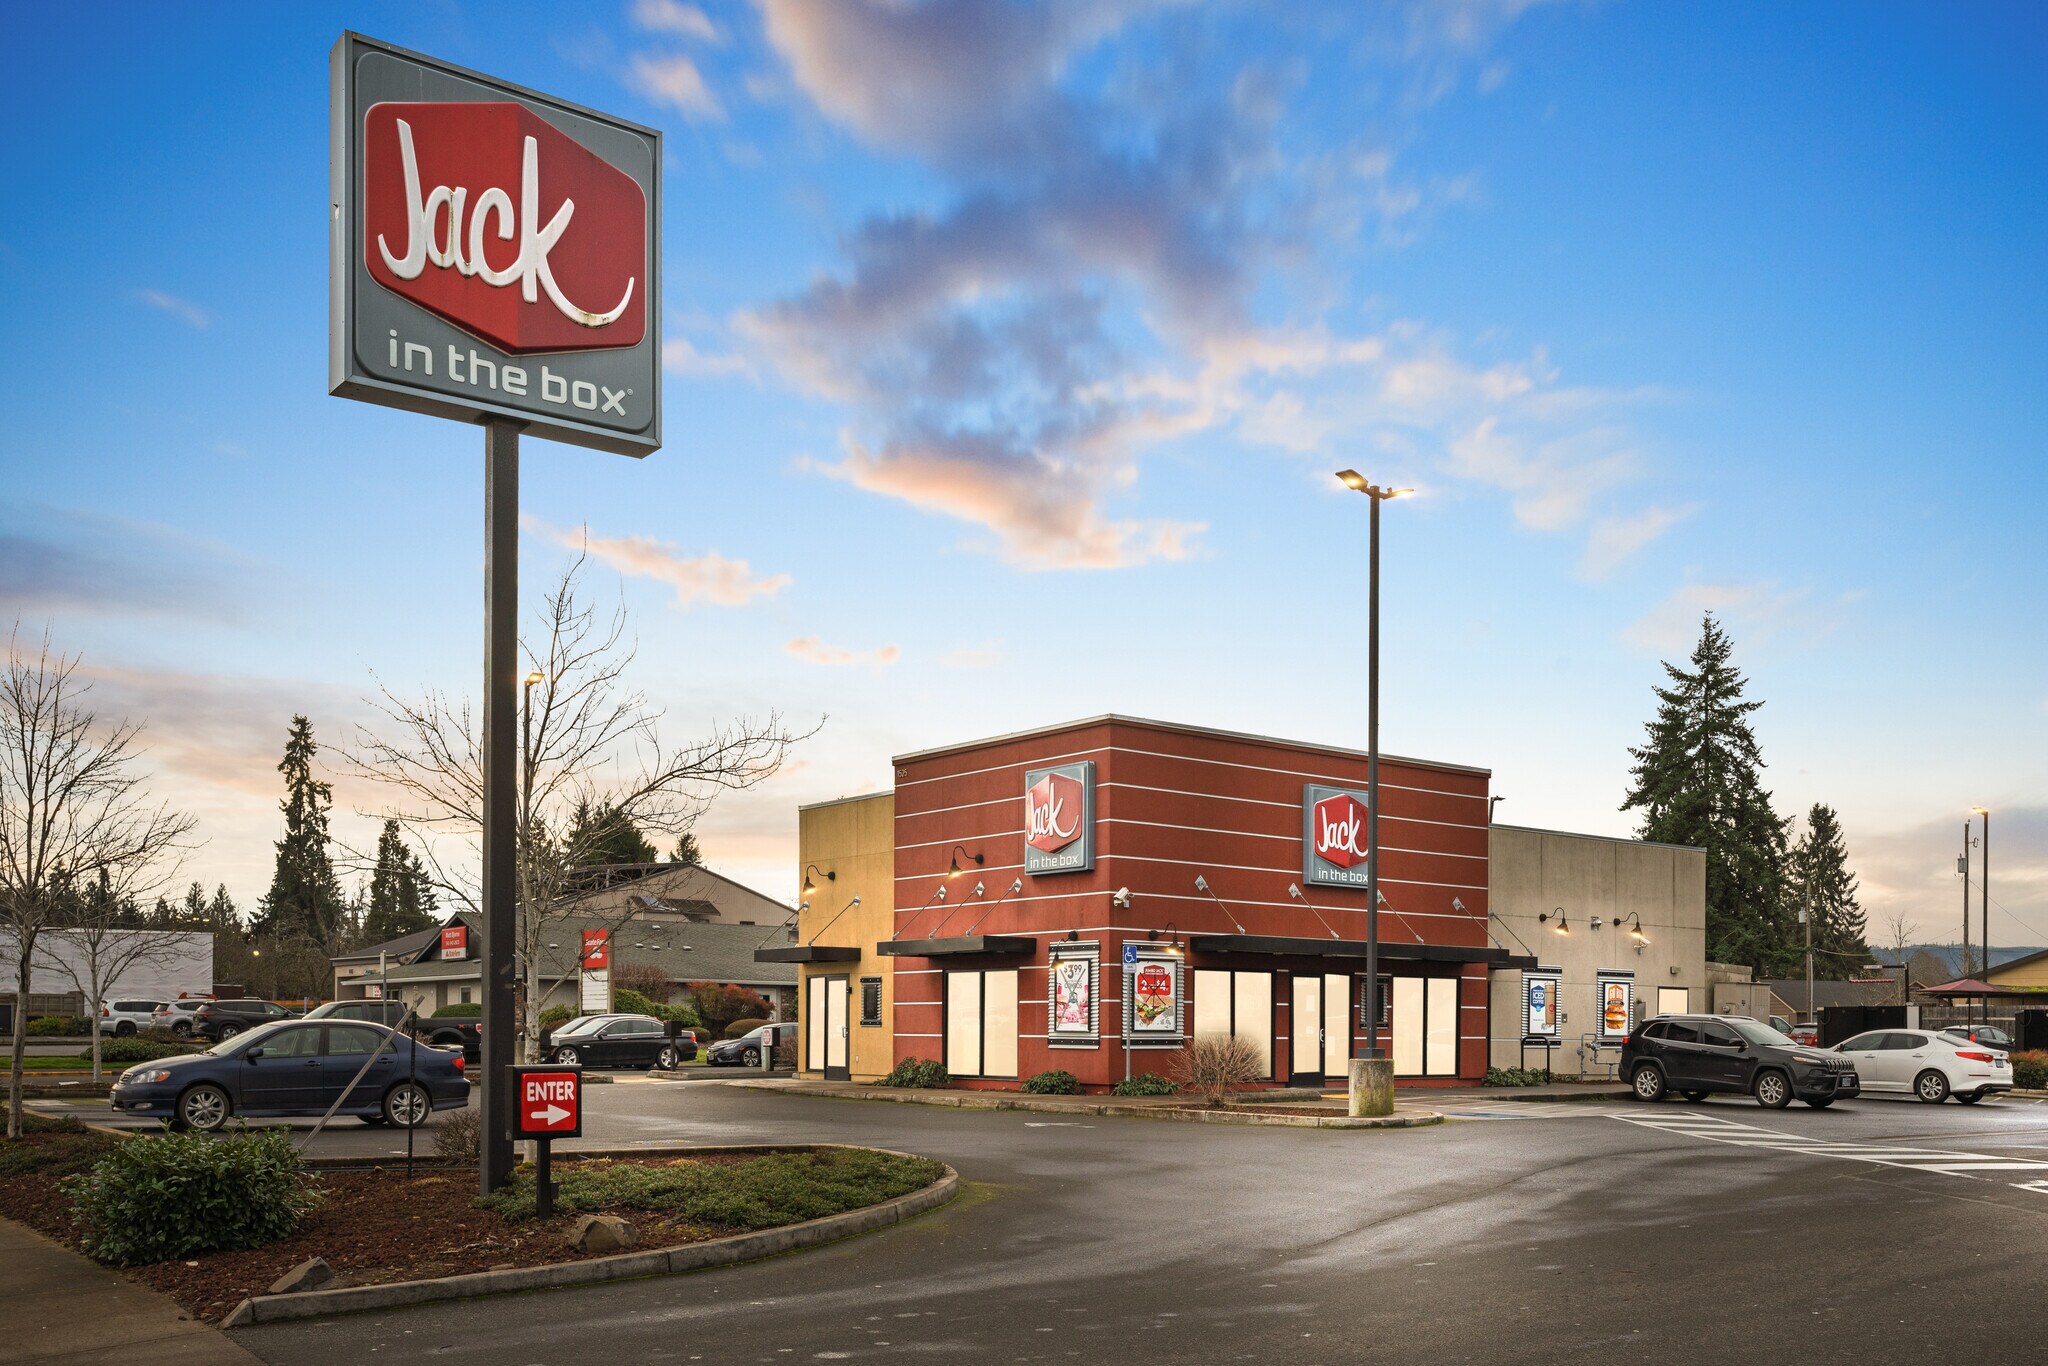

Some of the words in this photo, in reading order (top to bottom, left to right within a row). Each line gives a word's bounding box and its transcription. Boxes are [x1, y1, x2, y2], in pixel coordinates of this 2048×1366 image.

[378, 118, 635, 328] Jack
[389, 329, 433, 376] in
[448, 344, 528, 396] the
[541, 365, 626, 417] box
[1027, 782, 1080, 841] Jack
[1317, 803, 1368, 857] Jack
[1030, 857, 1039, 869] in
[1041, 856, 1058, 868] the
[1059, 854, 1079, 866] box
[1318, 867, 1328, 880] in
[1330, 869, 1347, 881] the
[1349, 870, 1368, 883] box
[526, 1081, 575, 1102] ENTER
